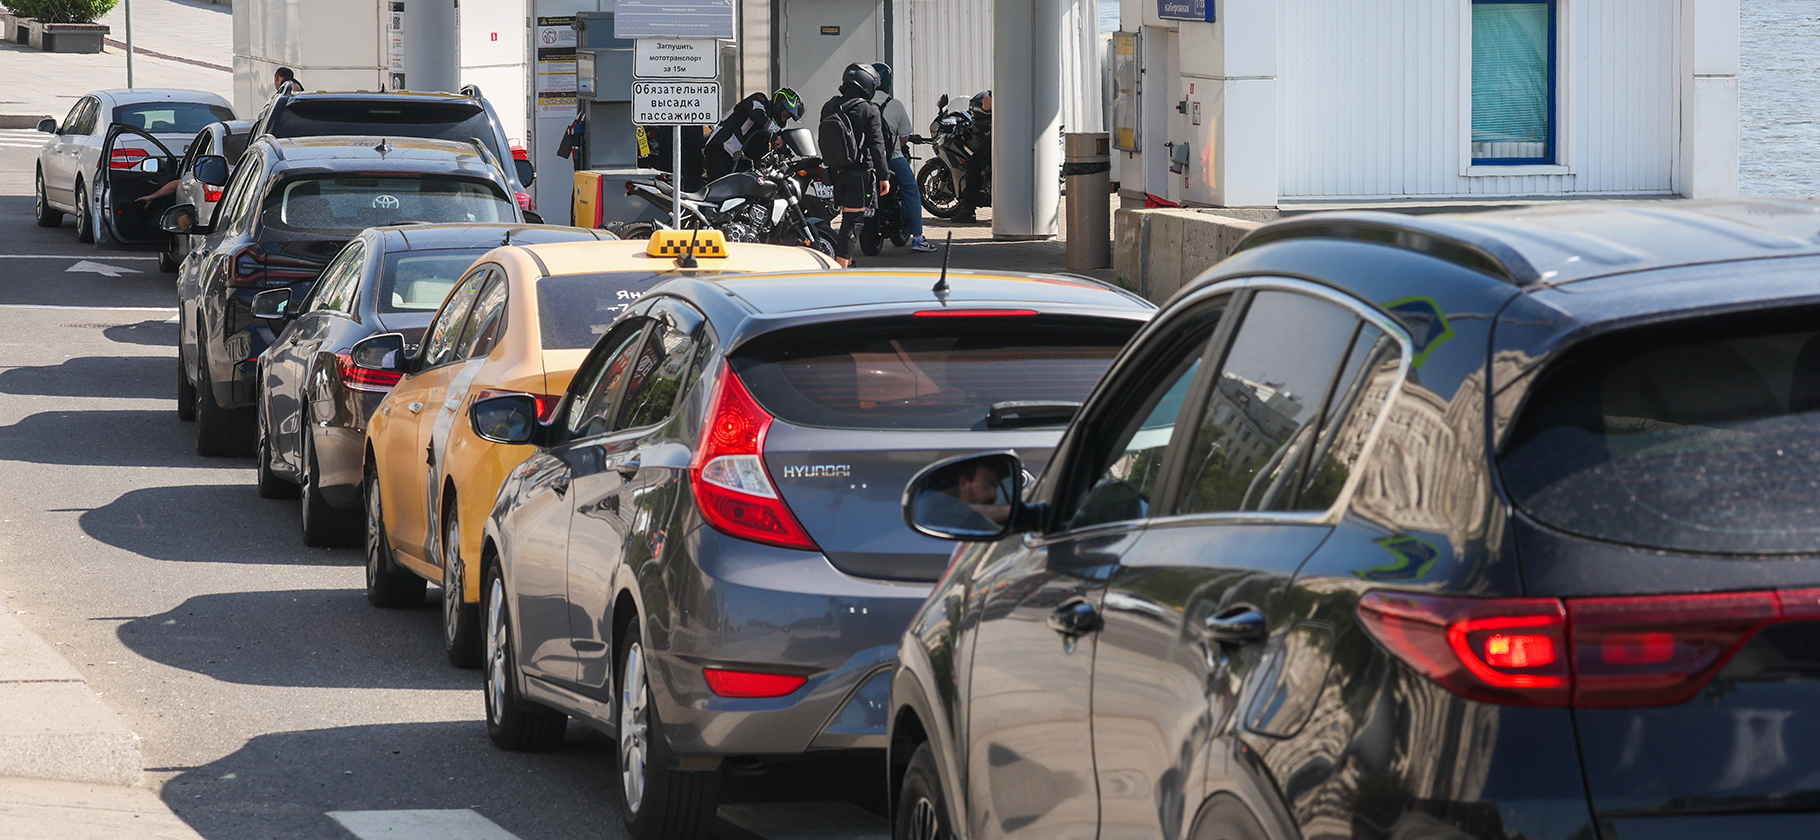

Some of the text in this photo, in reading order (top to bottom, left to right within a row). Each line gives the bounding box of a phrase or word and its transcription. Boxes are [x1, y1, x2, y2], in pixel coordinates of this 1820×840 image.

[656, 42, 694, 51] Заглушить
[635, 84, 717, 95] Обязательная
[650, 99, 701, 108] высадка
[640, 112, 711, 122] пассажиров
[616, 289, 646, 300] Ян
[783, 464, 851, 479] HYUNDAI
